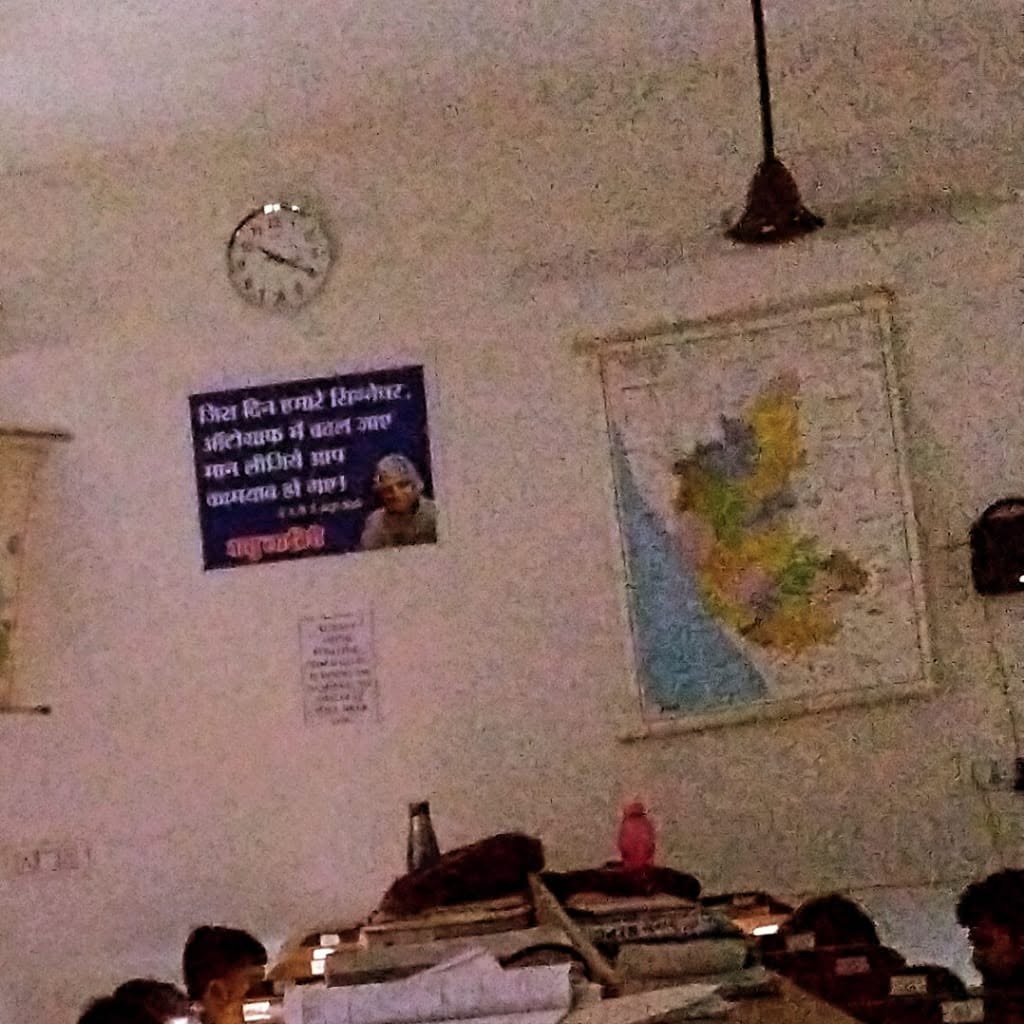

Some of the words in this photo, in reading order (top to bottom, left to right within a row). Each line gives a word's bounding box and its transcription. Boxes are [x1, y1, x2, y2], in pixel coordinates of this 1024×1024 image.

[199, 402, 236, 424] जिस
[242, 398, 276, 418] दिन
[279, 387, 323, 414] हमारे
